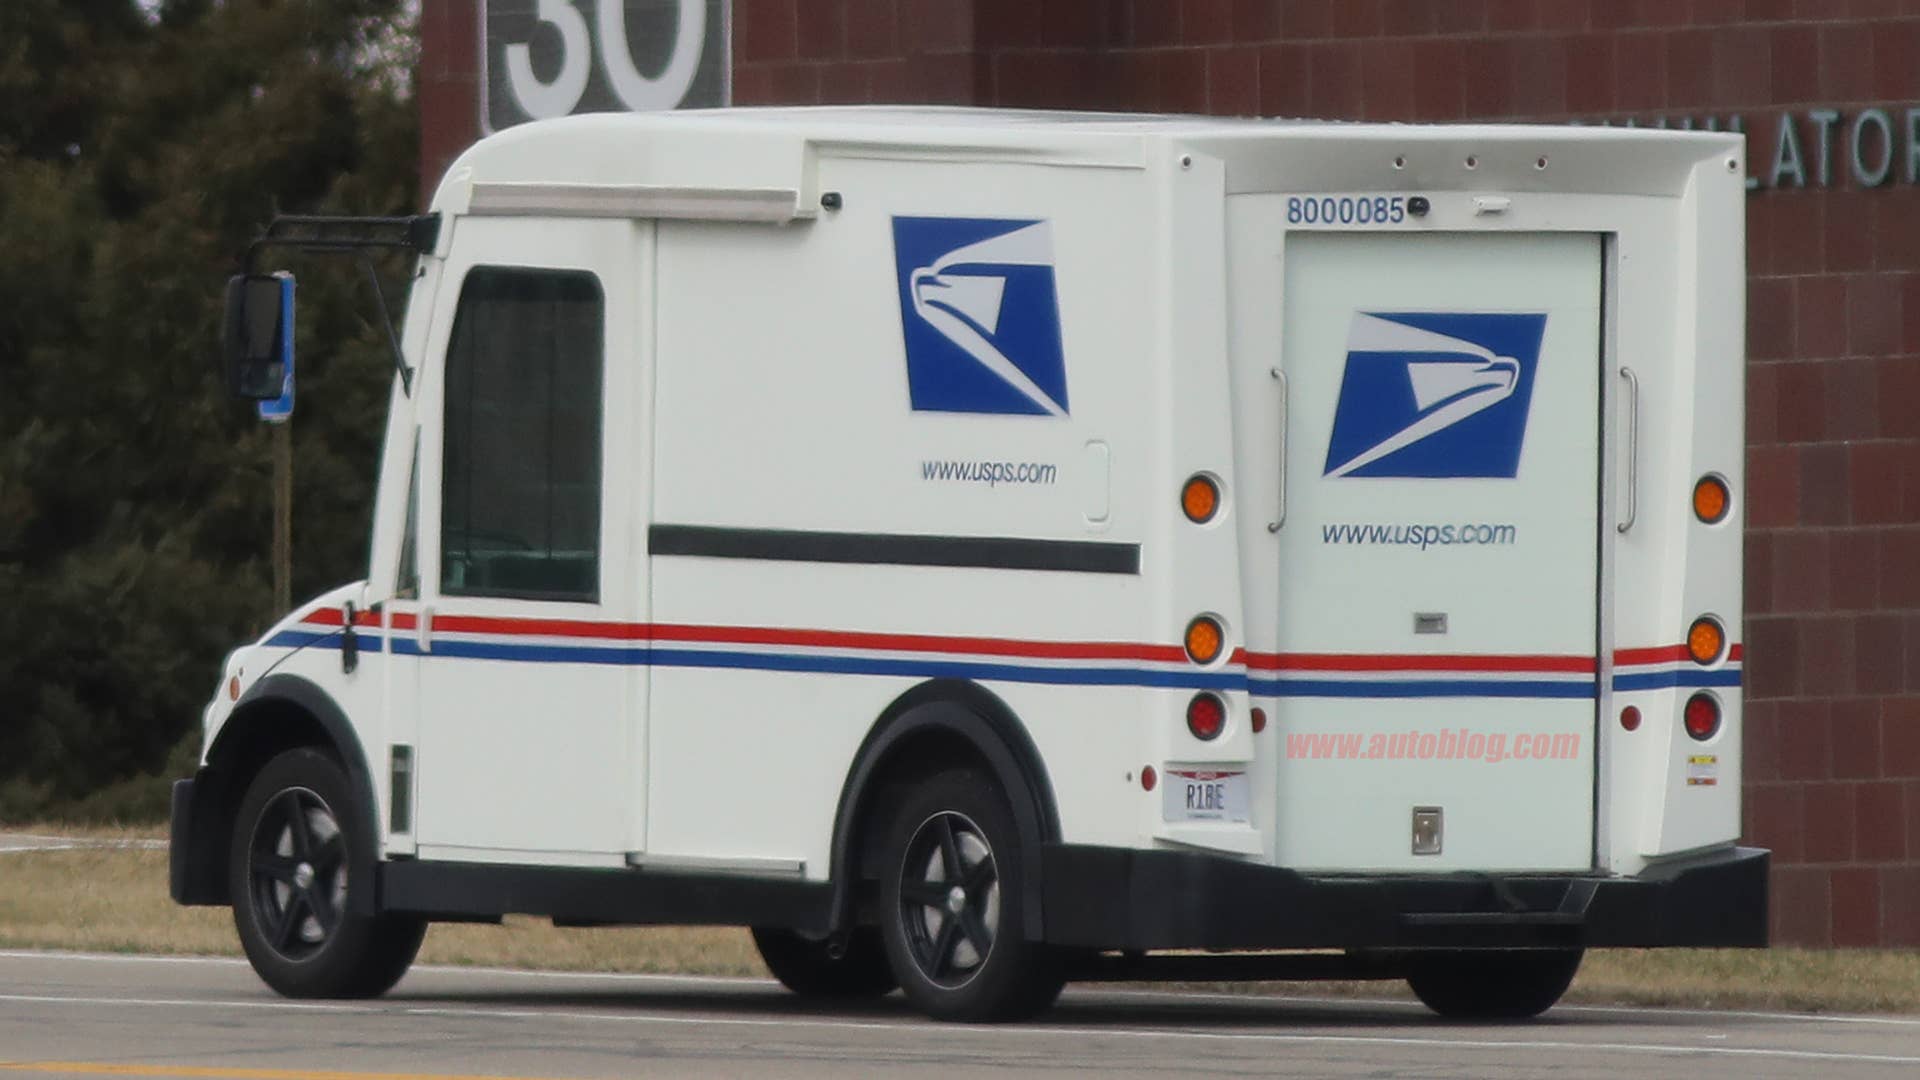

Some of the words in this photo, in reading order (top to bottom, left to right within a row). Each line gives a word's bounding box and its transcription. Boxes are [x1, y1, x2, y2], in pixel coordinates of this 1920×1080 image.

[506, 0, 706, 118] 30
[1287, 197, 1404, 223] 8000085
[922, 461, 1056, 487] www.usps.com
[1322, 524, 1515, 551] www.usps.com
